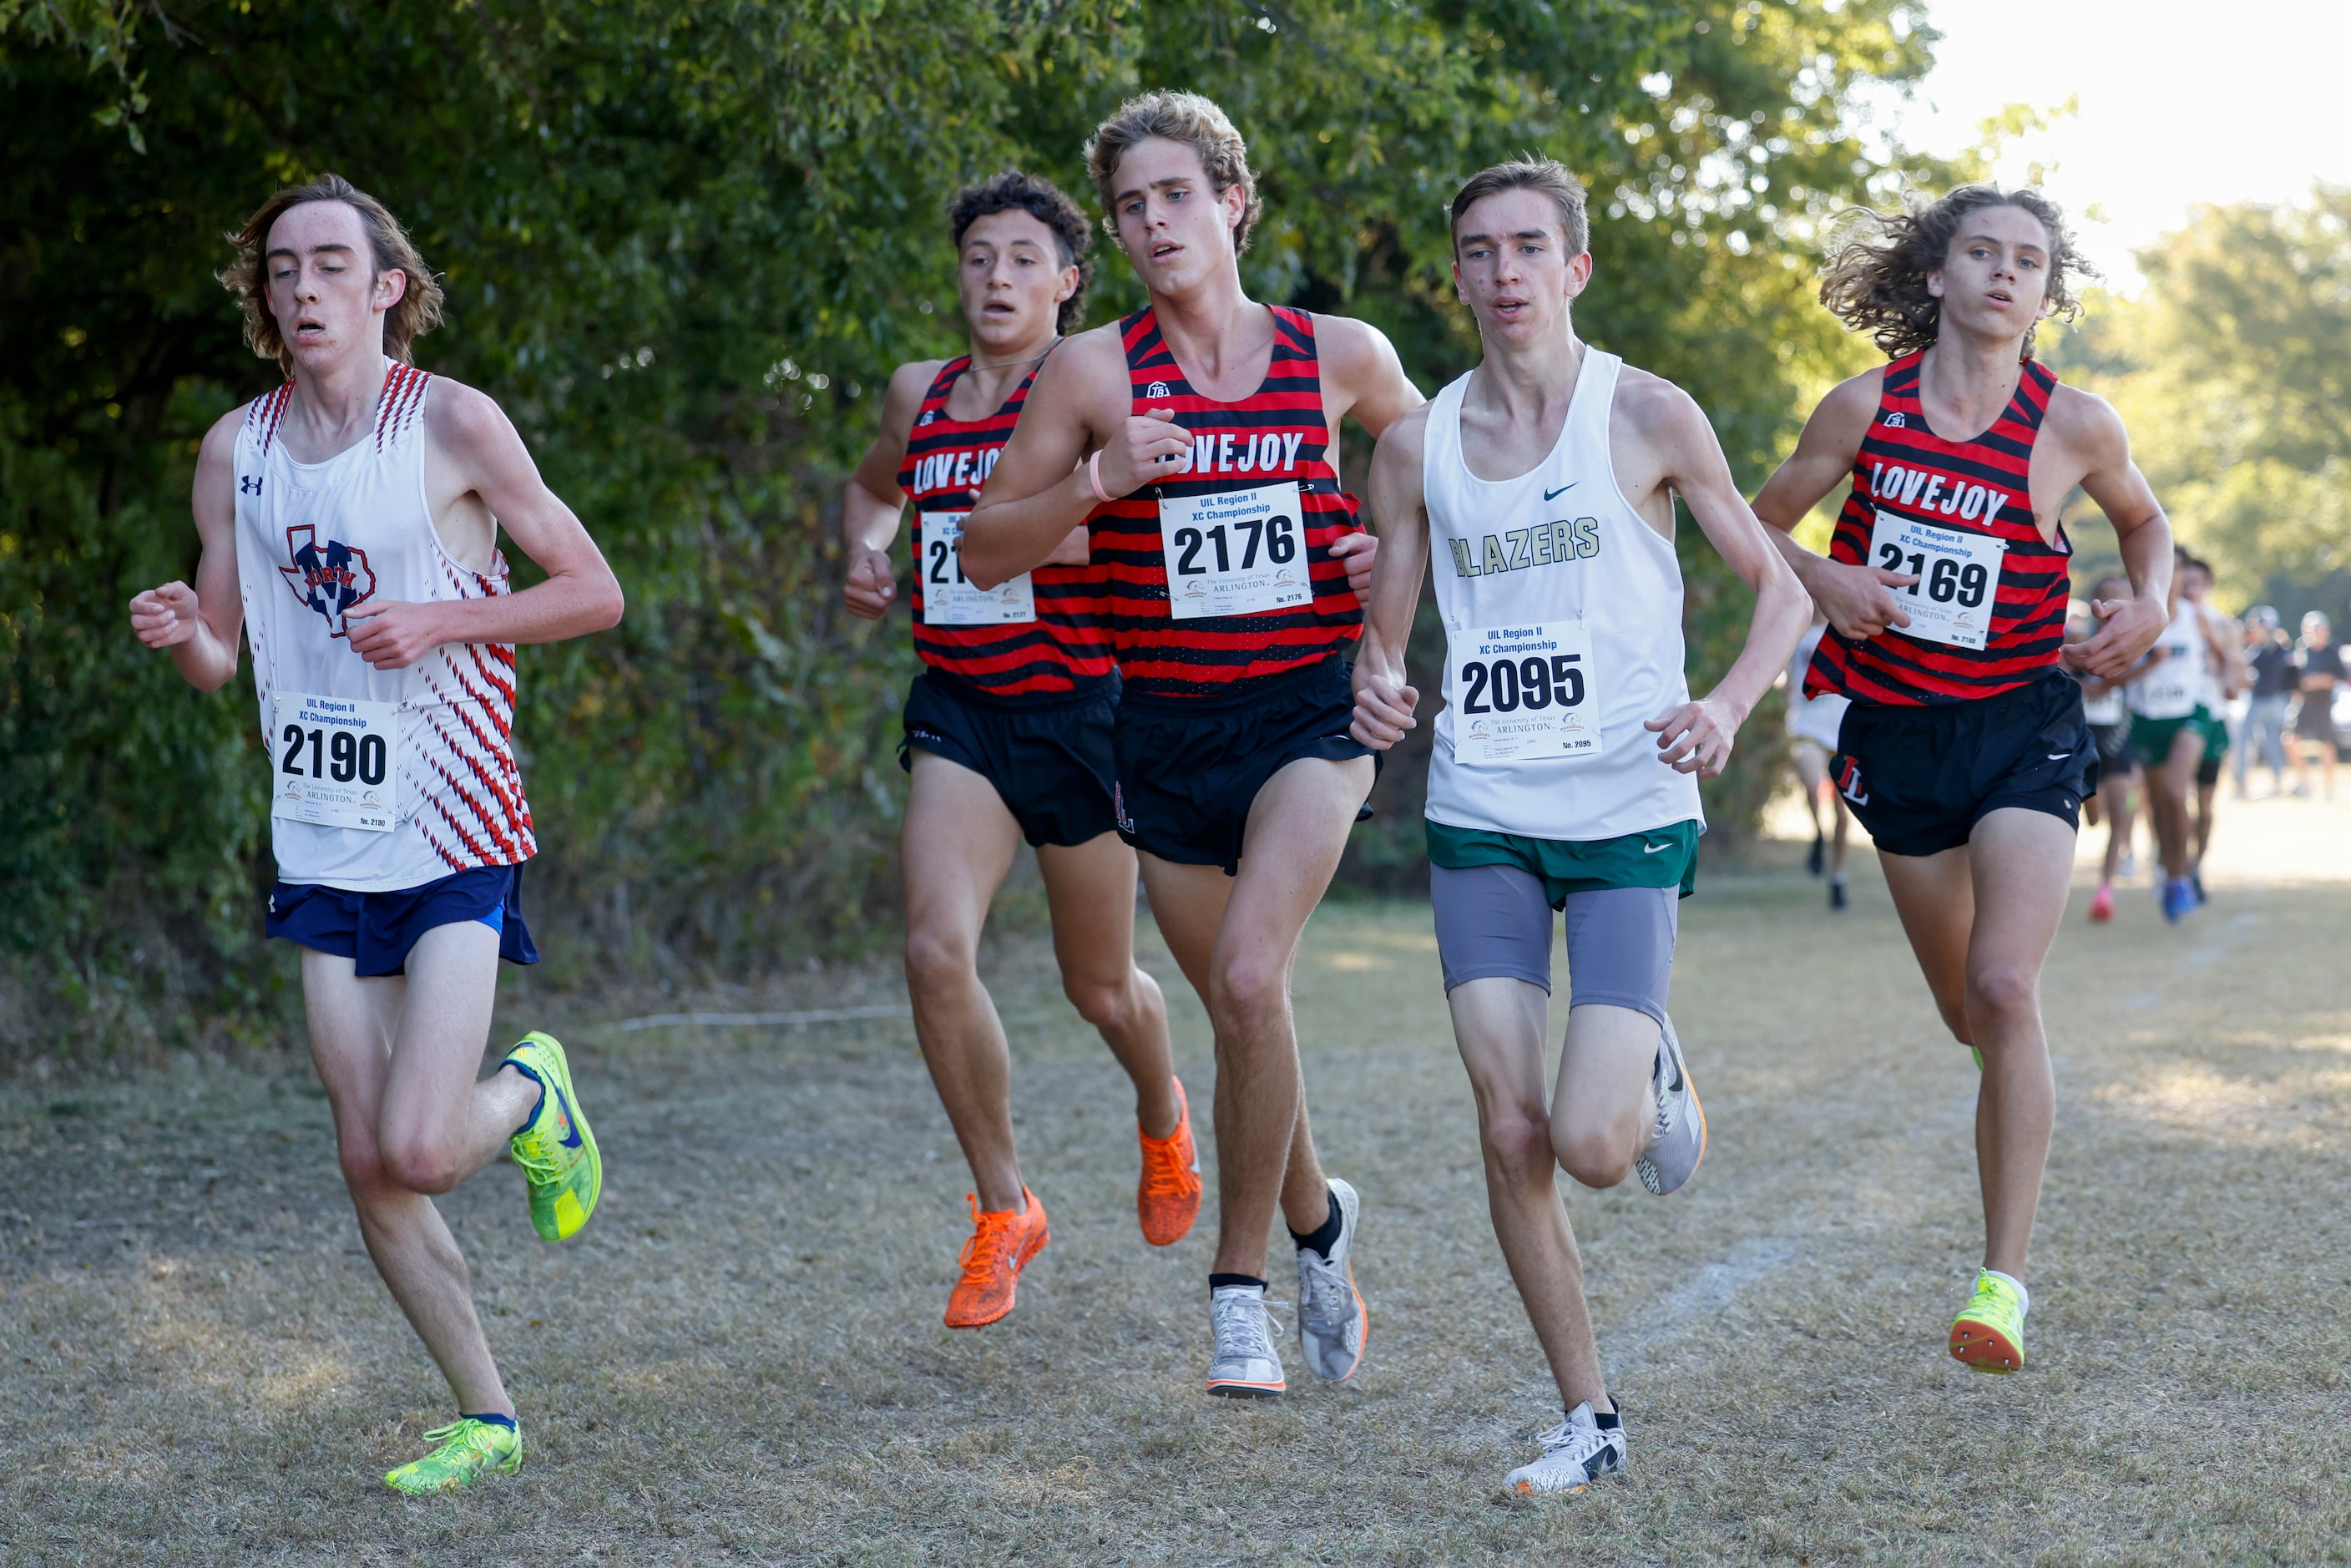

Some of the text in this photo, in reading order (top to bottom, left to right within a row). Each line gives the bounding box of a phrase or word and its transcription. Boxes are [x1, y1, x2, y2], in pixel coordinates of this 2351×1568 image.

[1159, 432, 1304, 474] OVEJOY
[913, 448, 1005, 495] LOVEJO
[1200, 492, 1257, 508] UIL Region II
[1870, 462, 2010, 527] LOVEJOY
[1192, 503, 1272, 522] XC Championship
[1910, 524, 1964, 544] UIL Region II
[1174, 514, 1296, 576] 2176
[1899, 534, 1973, 559] XC Championship
[1219, 575, 1246, 584] University
[1878, 543, 1988, 608] 2169
[1213, 580, 1267, 593] ARLINGTON
[1287, 593, 1303, 602] 2176
[1488, 626, 1543, 640] UIL Region II
[1479, 640, 1558, 655] XC Championship
[1462, 654, 1585, 715] 2095
[306, 698, 356, 712] UIL Region II
[299, 710, 367, 729] XC Championship
[1502, 716, 1529, 725] University
[1496, 722, 1551, 735] ARLINGTON
[1562, 740, 1592, 750] No. 2095
[282, 724, 387, 786] 2190
[311, 784, 334, 794] University
[307, 791, 352, 803] ARLINGTON
[361, 817, 386, 827] No. 2190
